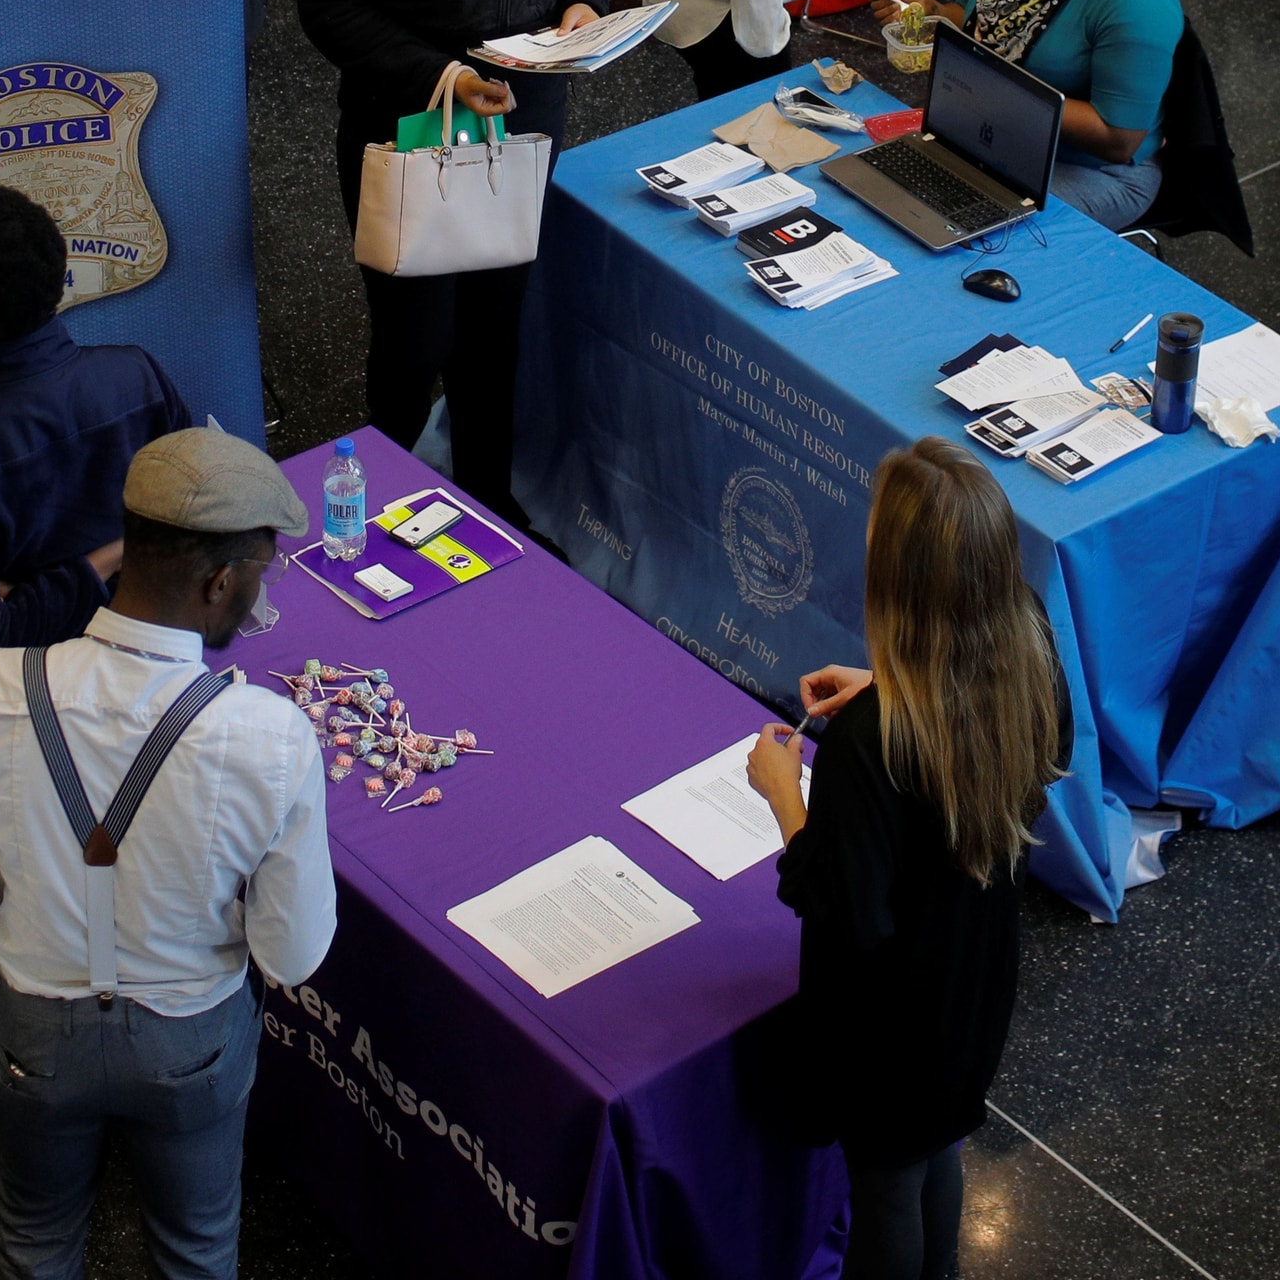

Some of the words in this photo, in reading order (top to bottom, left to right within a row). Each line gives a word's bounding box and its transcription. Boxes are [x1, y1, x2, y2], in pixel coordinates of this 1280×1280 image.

[39, 149, 57, 159] SIT
[58, 149, 87, 160] DEUS
[86, 152, 117, 167] NOBIS
[72, 238, 140, 262] NATION
[650, 330, 709, 383] OFFICE
[710, 370, 734, 397] OF
[735, 385, 800, 442] HUMAN
[801, 428, 872, 490] RESOUR
[704, 333, 744, 372] CITY
[747, 360, 772, 388] OF
[775, 376, 846, 438] BOSTON
[696, 394, 740, 434] Mayor
[741, 423, 787, 466] Martin
[789, 456, 802, 477] J.
[805, 465, 849, 509] Walsh
[326, 503, 359, 519] POLAR
[577, 503, 633, 561] THRIVING
[716, 611, 780, 670] HEALTHY
[307, 1030, 406, 1161] Boston
[350, 1025, 580, 1247] Associatio
